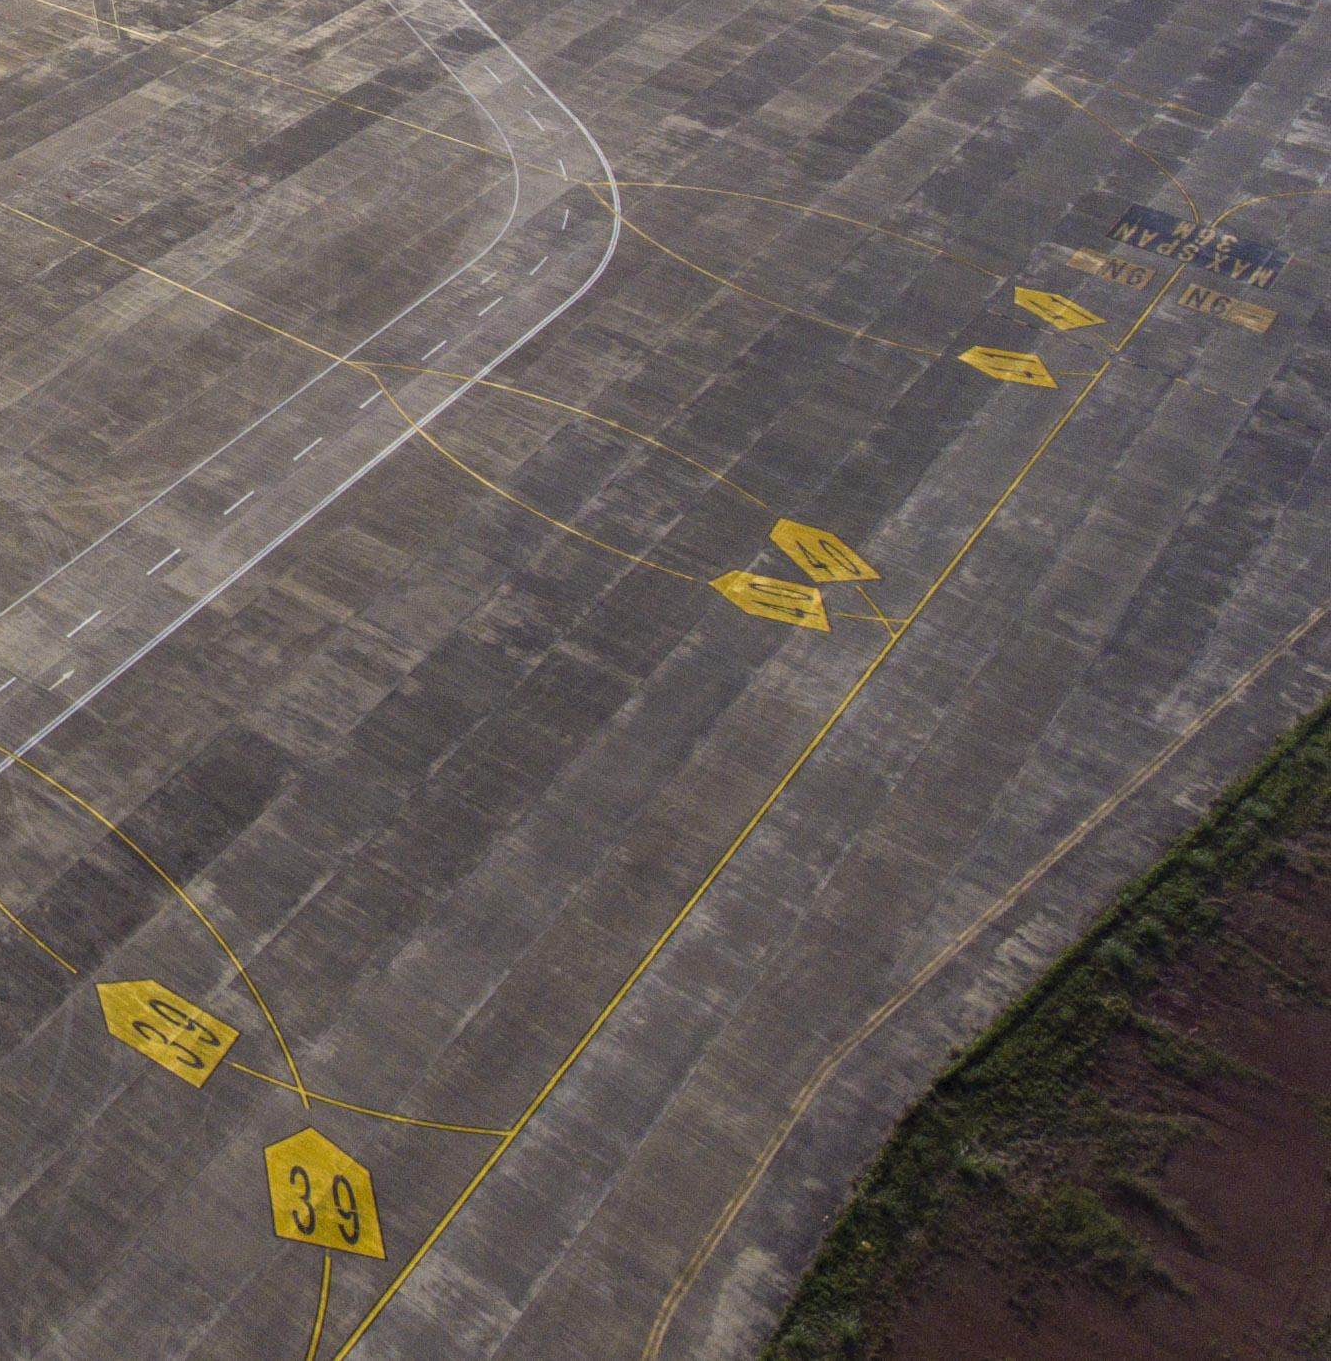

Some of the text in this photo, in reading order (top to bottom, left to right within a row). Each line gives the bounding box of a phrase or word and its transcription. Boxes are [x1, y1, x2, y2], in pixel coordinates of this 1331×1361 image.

[1113, 222, 1276, 287] MAX SPAN
[1171, 220, 1238, 252] 36M
[795, 539, 861, 578] 40
[747, 582, 821, 619] 40
[132, 998, 221, 1070] 39
[290, 1165, 360, 1246] 39
